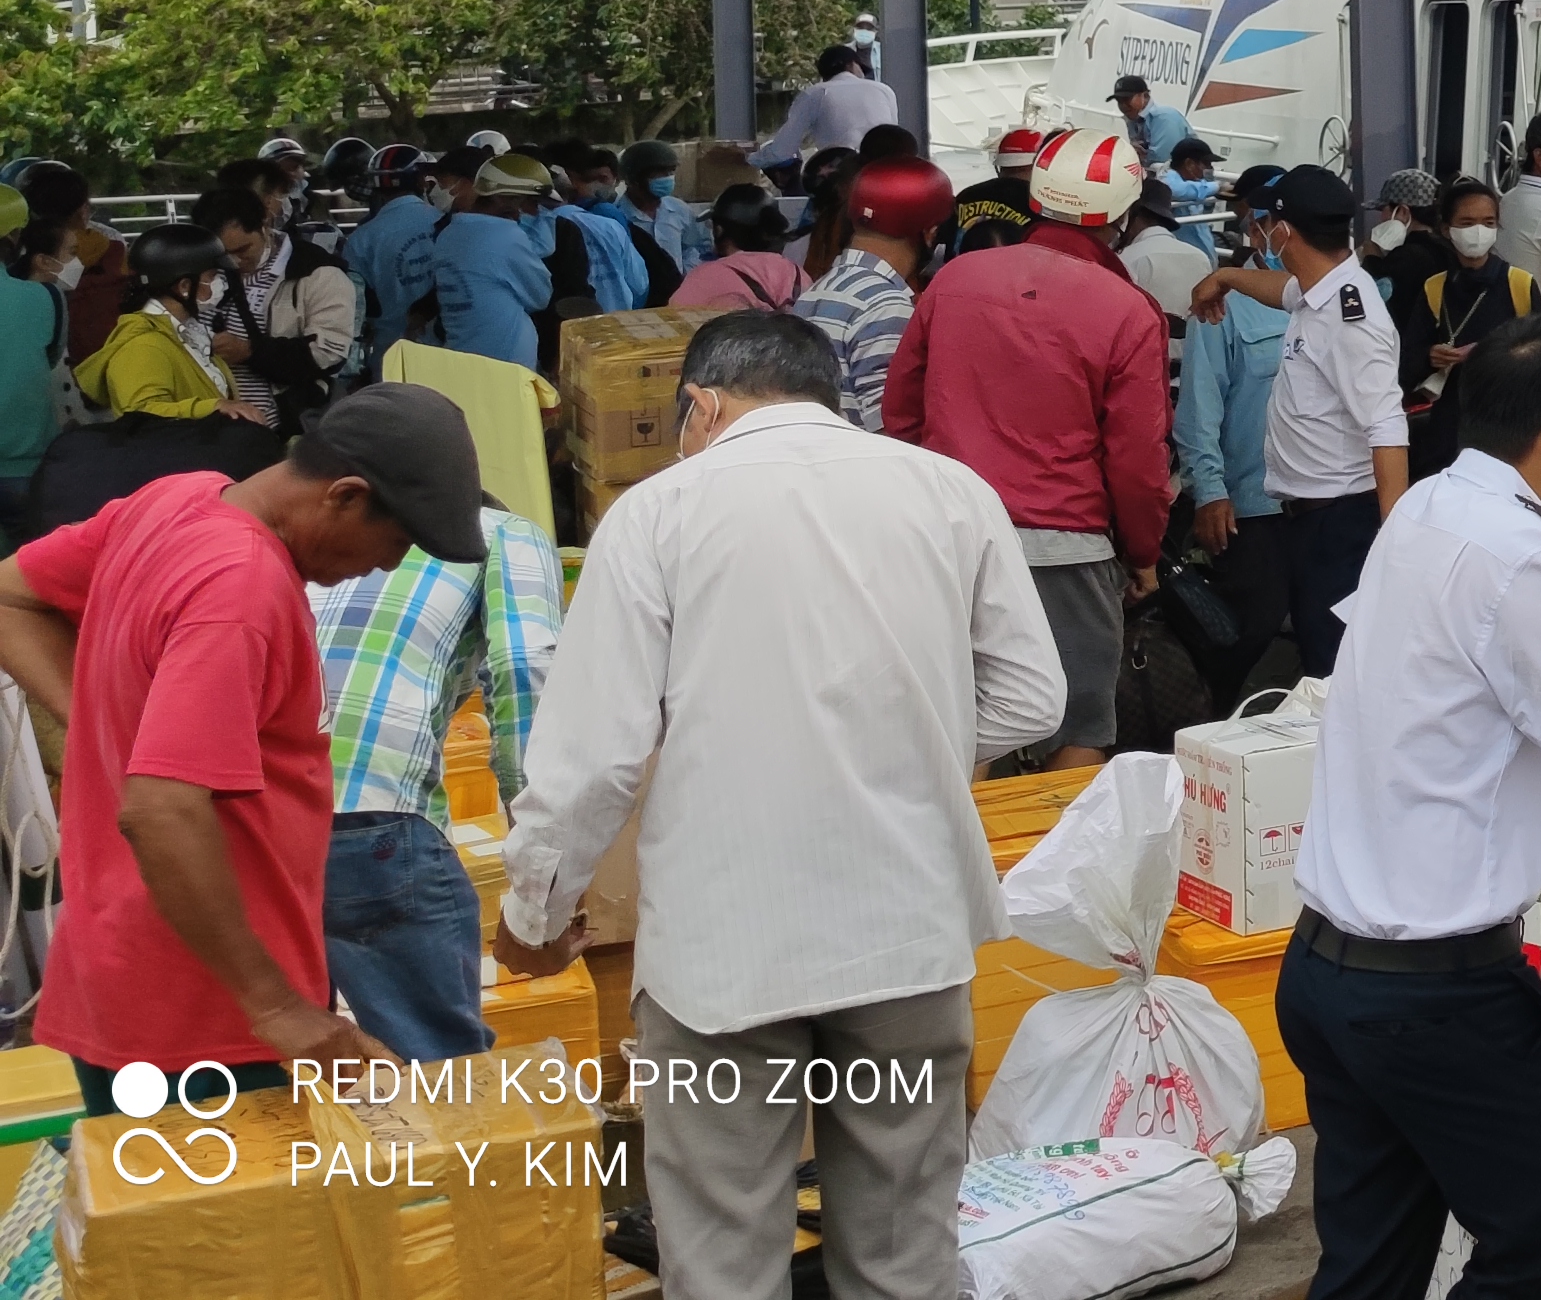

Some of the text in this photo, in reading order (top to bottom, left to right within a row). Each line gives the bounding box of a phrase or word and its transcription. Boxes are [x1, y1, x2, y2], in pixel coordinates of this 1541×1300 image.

[1117, 36, 1192, 86] SUPERDONG
[958, 200, 1031, 226] DESTRUCTION
[1184, 773, 1197, 801] HÚ
